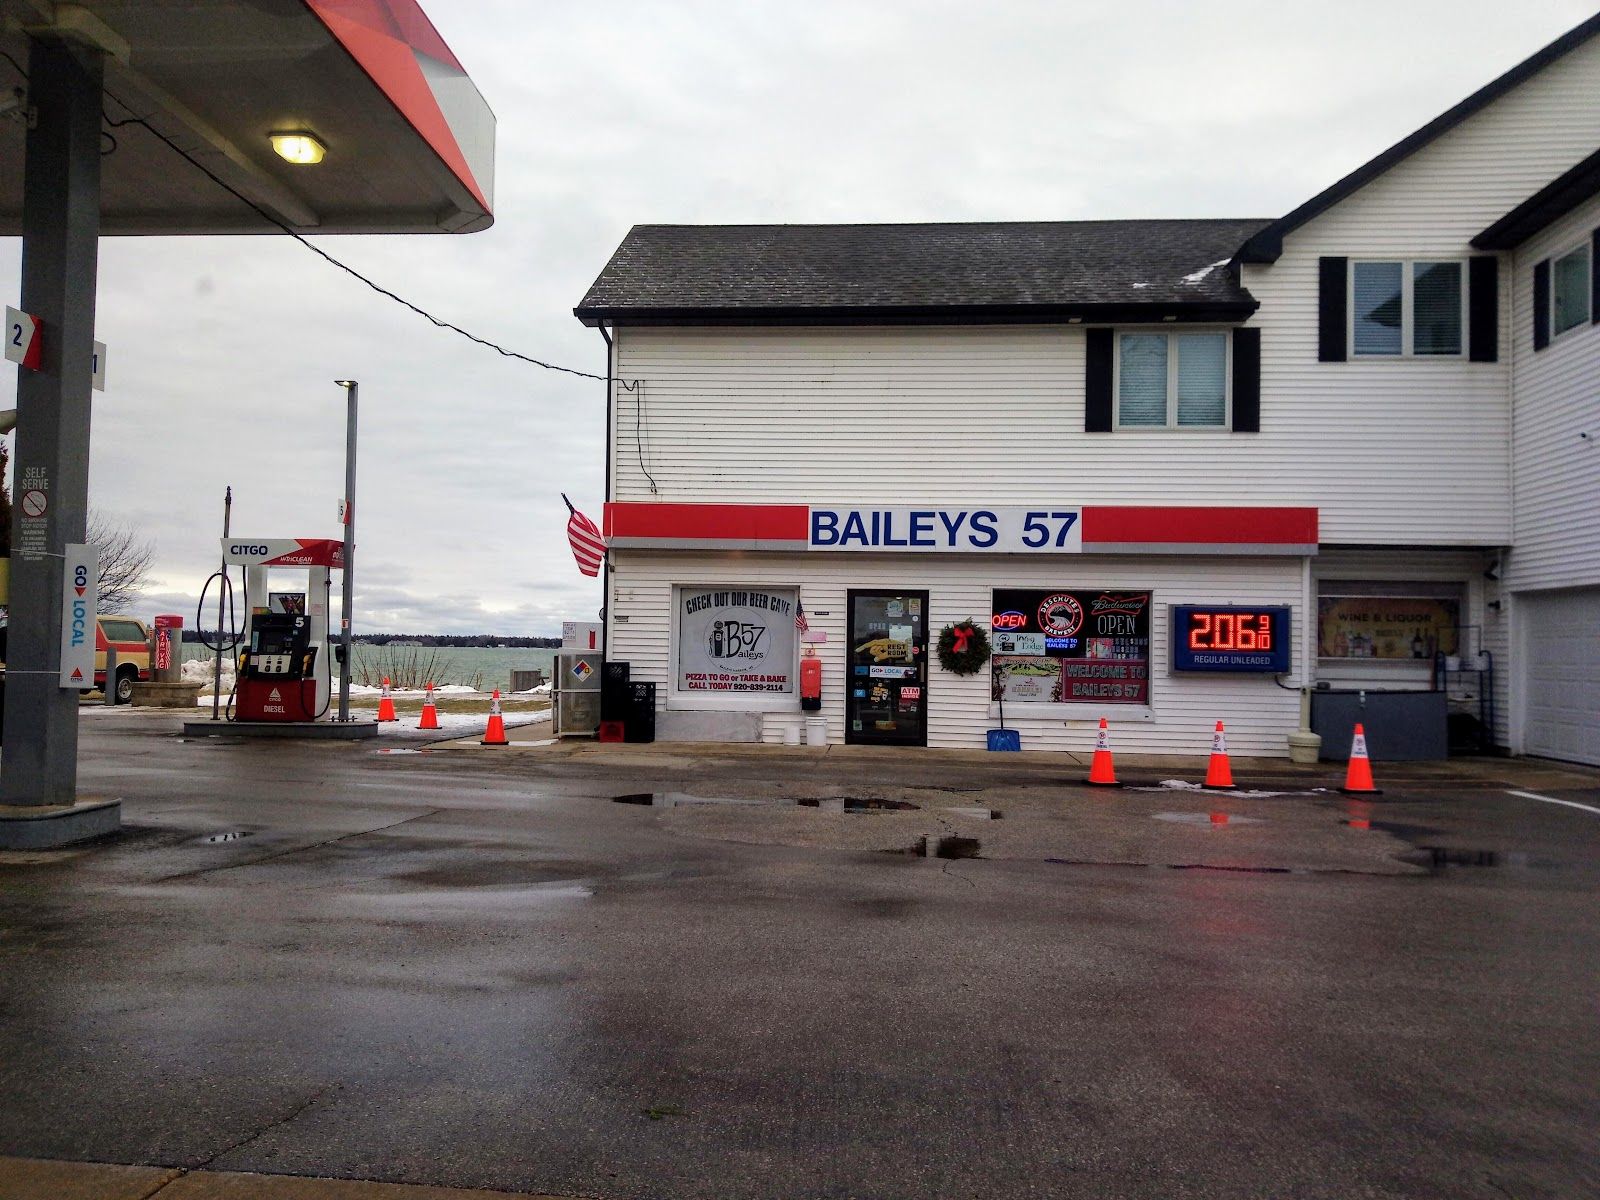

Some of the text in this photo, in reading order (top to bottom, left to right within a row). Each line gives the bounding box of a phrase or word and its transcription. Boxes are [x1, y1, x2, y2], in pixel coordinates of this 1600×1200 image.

[13, 323, 22, 347] 2
[25, 467, 47, 478] SELF
[22, 478, 49, 490] SERVE
[811, 510, 1078, 548] BAILEYS 57
[230, 545, 268, 556] CITGO
[72, 565, 87, 647] GO LOCAL
[686, 591, 791, 616] CHECK OUT OUR BEER CAVE
[1040, 596, 1080, 614] DESCHUTES
[294, 616, 305, 628] 5
[992, 614, 1027, 627] OPEN
[1338, 613, 1369, 621] WINE
[1386, 613, 1432, 622] LIQUOR
[1044, 625, 1076, 636] BREWERY
[1097, 615, 1137, 635] OPEN
[1191, 614, 1256, 649] 2.06
[1194, 655, 1271, 665] REGULAR UNLEADED
[1066, 664, 1147, 679] WELCOME TO
[708, 673, 718, 681] TO
[740, 674, 758, 682] TAKE
[767, 675, 787, 683] BAKE
[709, 682, 733, 690] TODAY
[733, 683, 783, 691] 920-839-2114
[1072, 683, 1141, 697] BAILEYS 57
[263, 705, 285, 713] DIESEL
